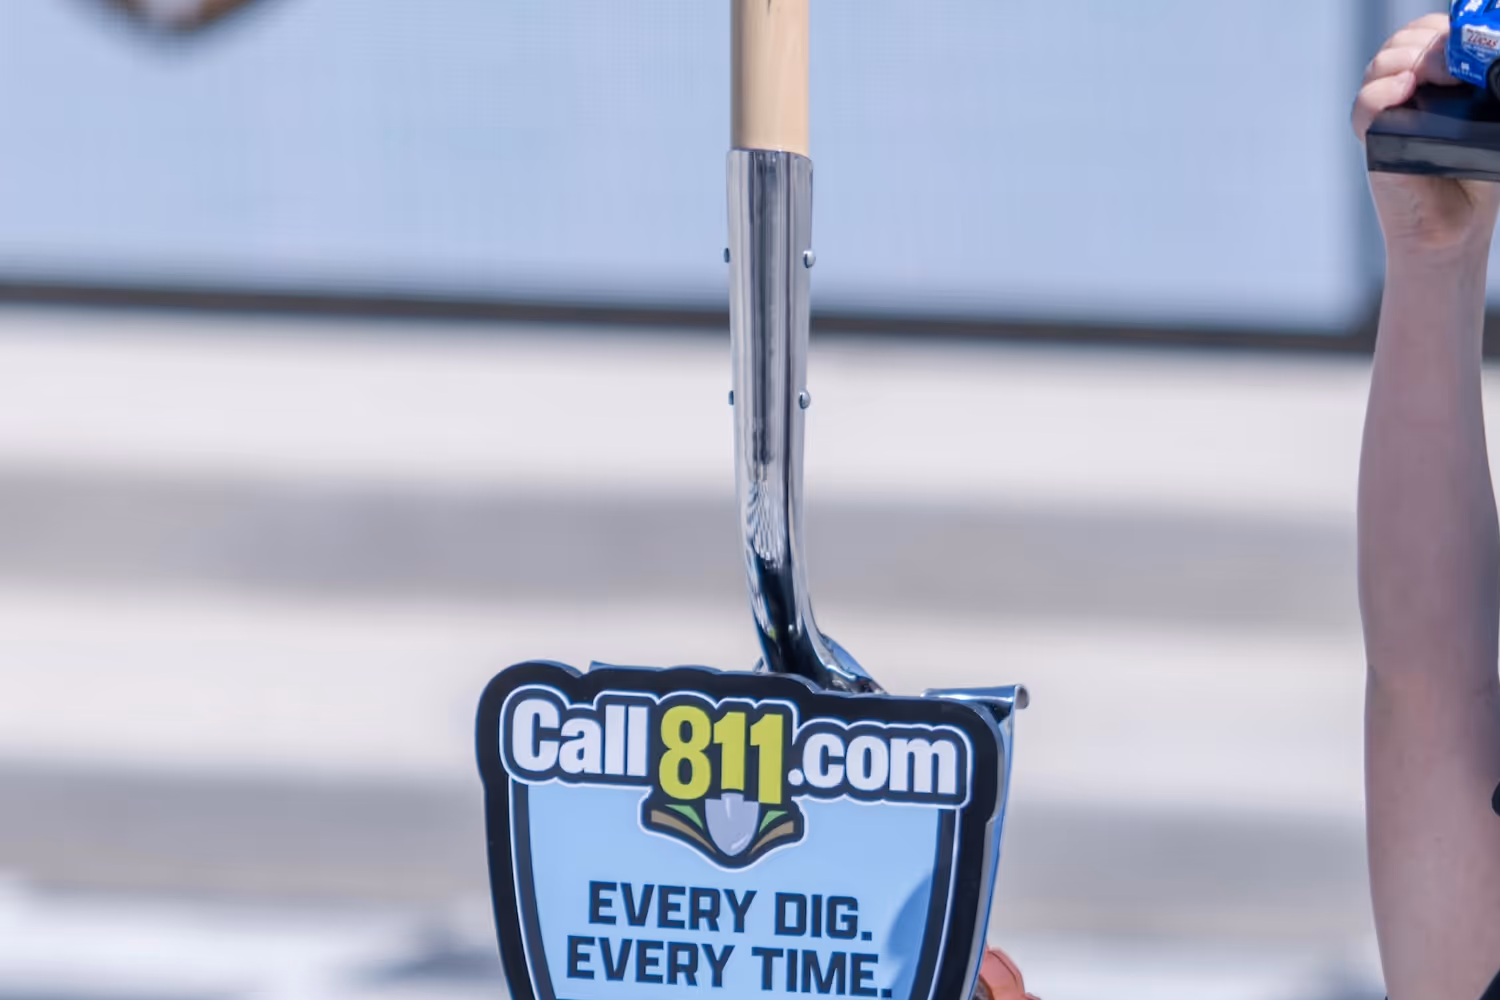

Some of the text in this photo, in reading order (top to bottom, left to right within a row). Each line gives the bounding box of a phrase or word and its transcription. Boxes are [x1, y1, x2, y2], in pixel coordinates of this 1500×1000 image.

[511, 697, 958, 805] Call811.com
[588, 880, 873, 942] EVERY DIG.
[566, 934, 893, 999] EVERY TIME.
